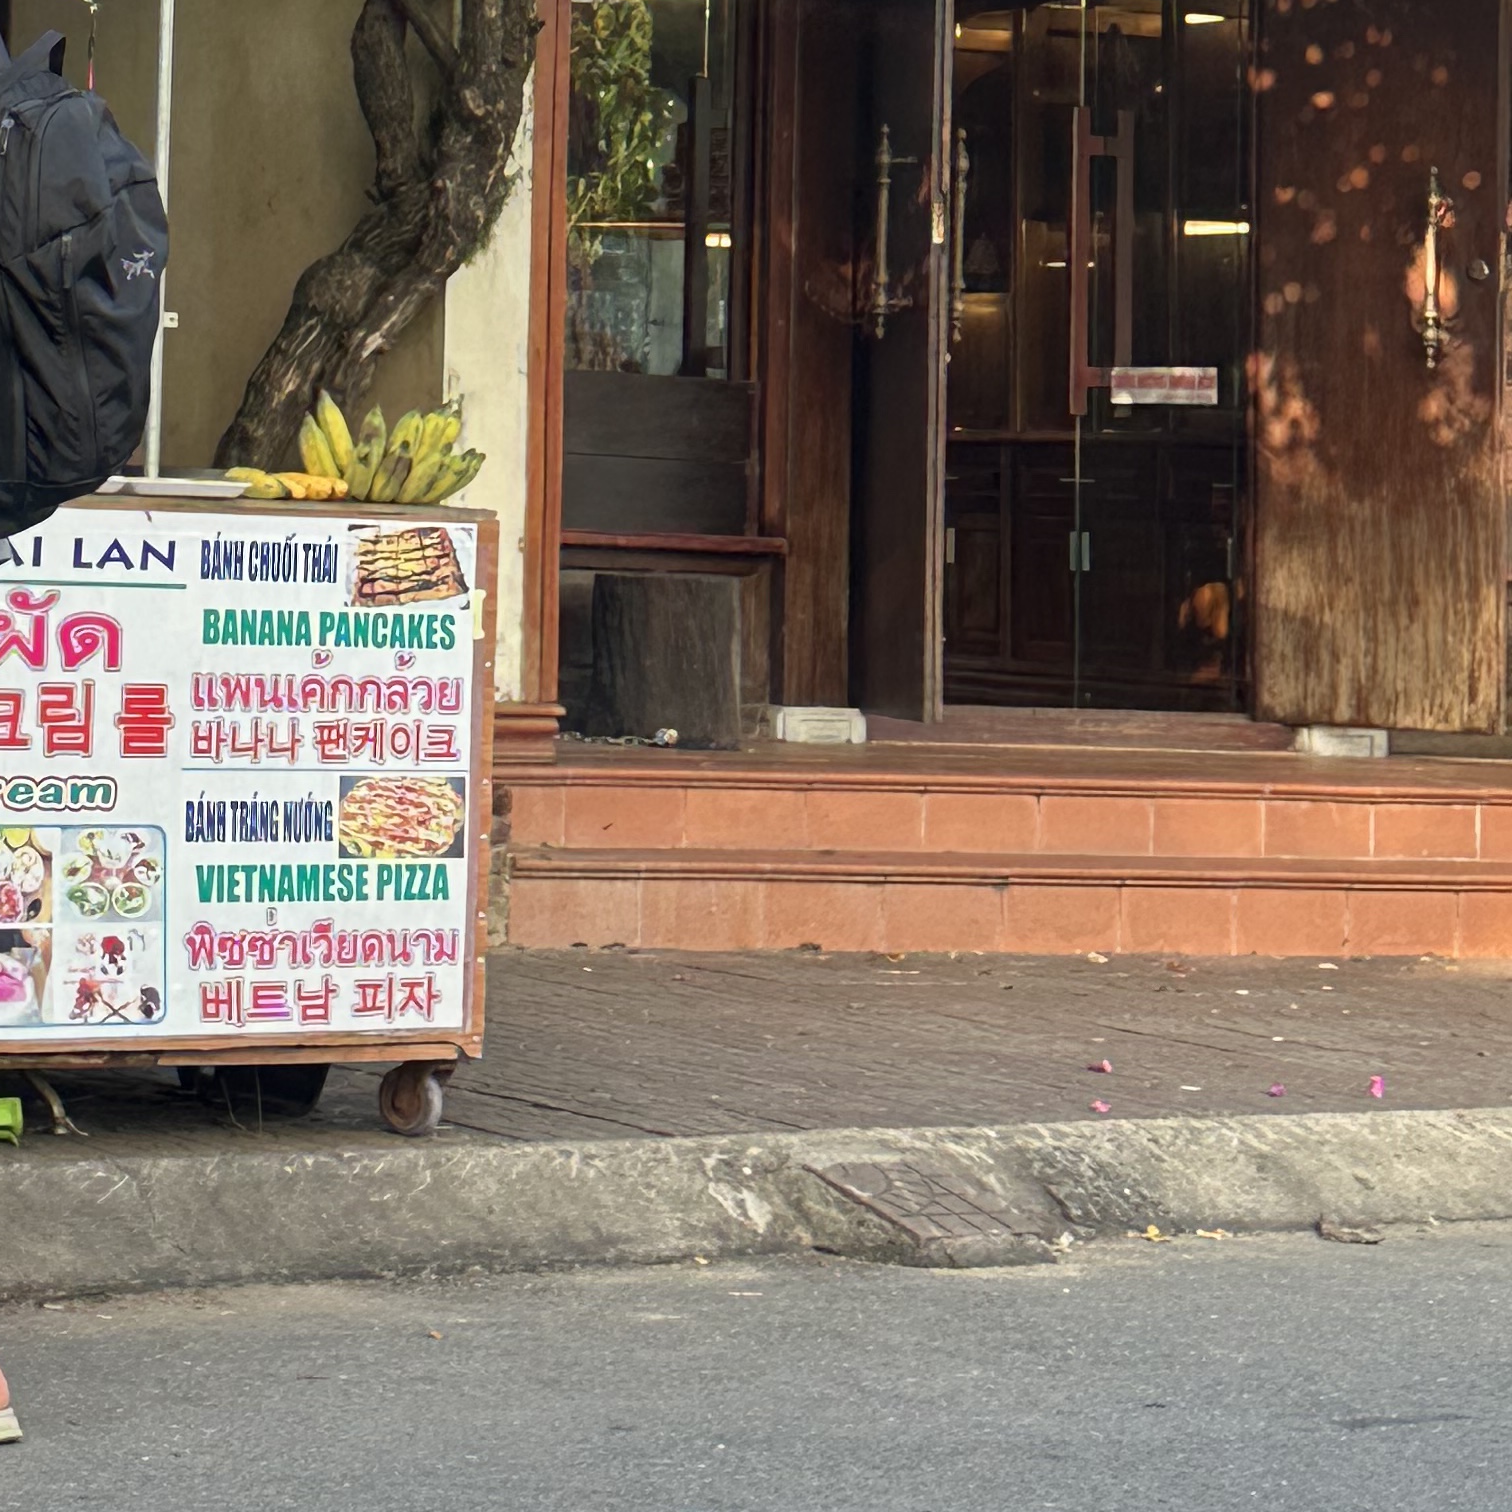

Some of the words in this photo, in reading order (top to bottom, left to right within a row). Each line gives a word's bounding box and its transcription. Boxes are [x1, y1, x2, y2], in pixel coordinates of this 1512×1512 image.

[73, 538, 176, 571] LAN
[200, 532, 244, 580] BÁNH
[302, 535, 338, 583] THÁI
[202, 608, 312, 646] BANANA
[319, 611, 456, 651] PANCAKES
[116, 686, 173, 755] 롤
[191, 718, 302, 763] 바나나
[315, 719, 459, 763] 팬케이크
[185, 791, 227, 843] BÁNH
[195, 863, 369, 903] VIETNAMESE
[376, 863, 450, 902] PIZZA
[199, 976, 338, 1025] 베트남
[354, 974, 440, 1021] 피자
